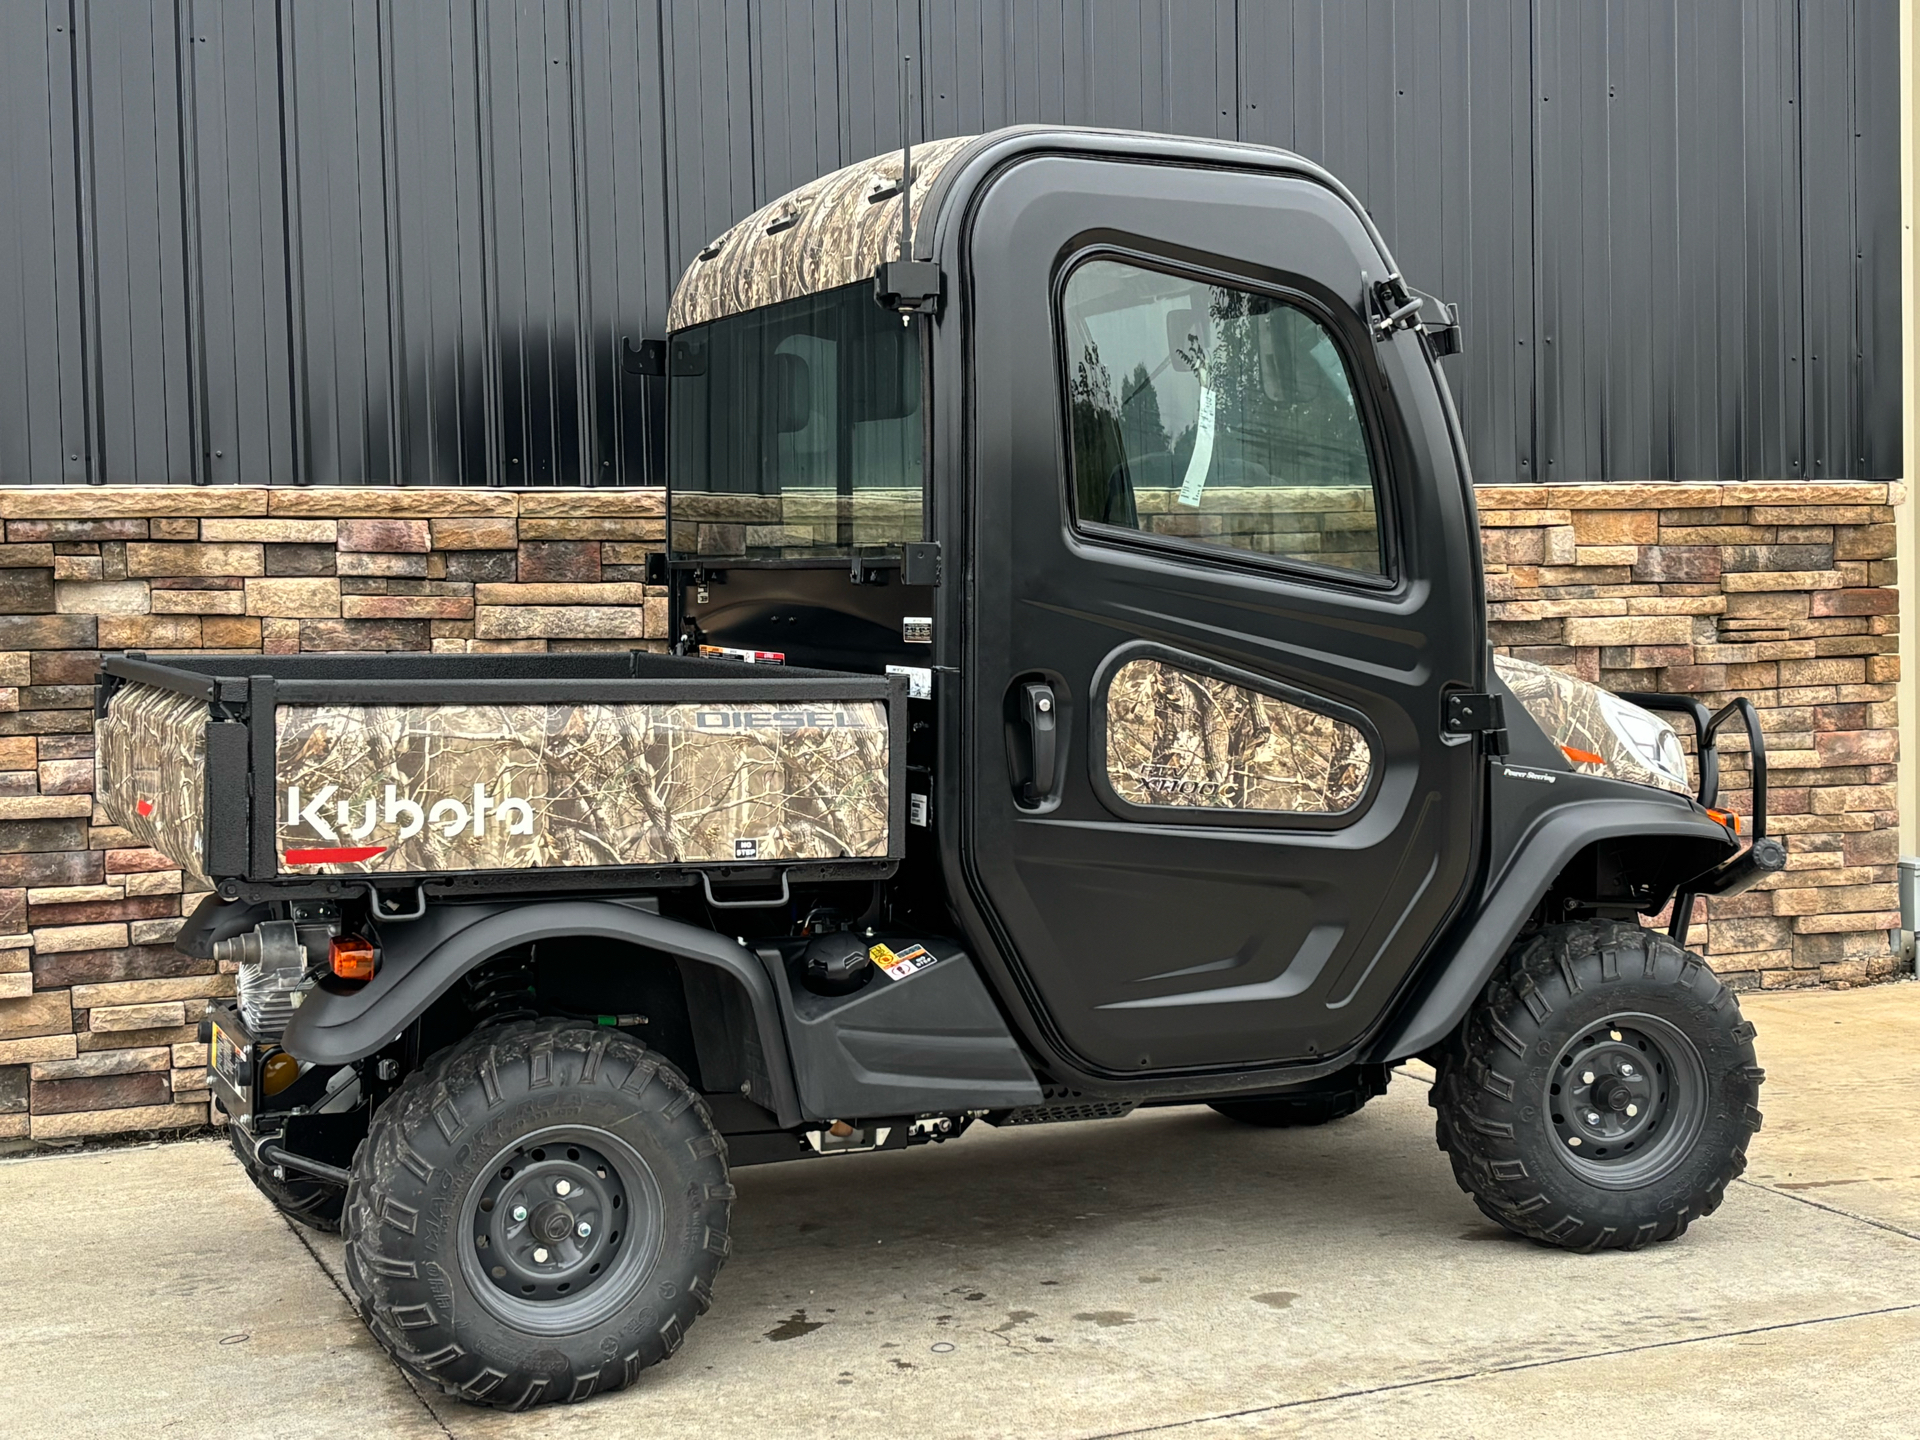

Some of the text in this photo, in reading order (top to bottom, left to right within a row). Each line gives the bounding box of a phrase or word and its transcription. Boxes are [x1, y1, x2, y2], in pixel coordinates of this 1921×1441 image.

[696, 712, 867, 728] DIESEL
[1503, 768, 1556, 783] Power Steering
[288, 783, 534, 840] Kubota
